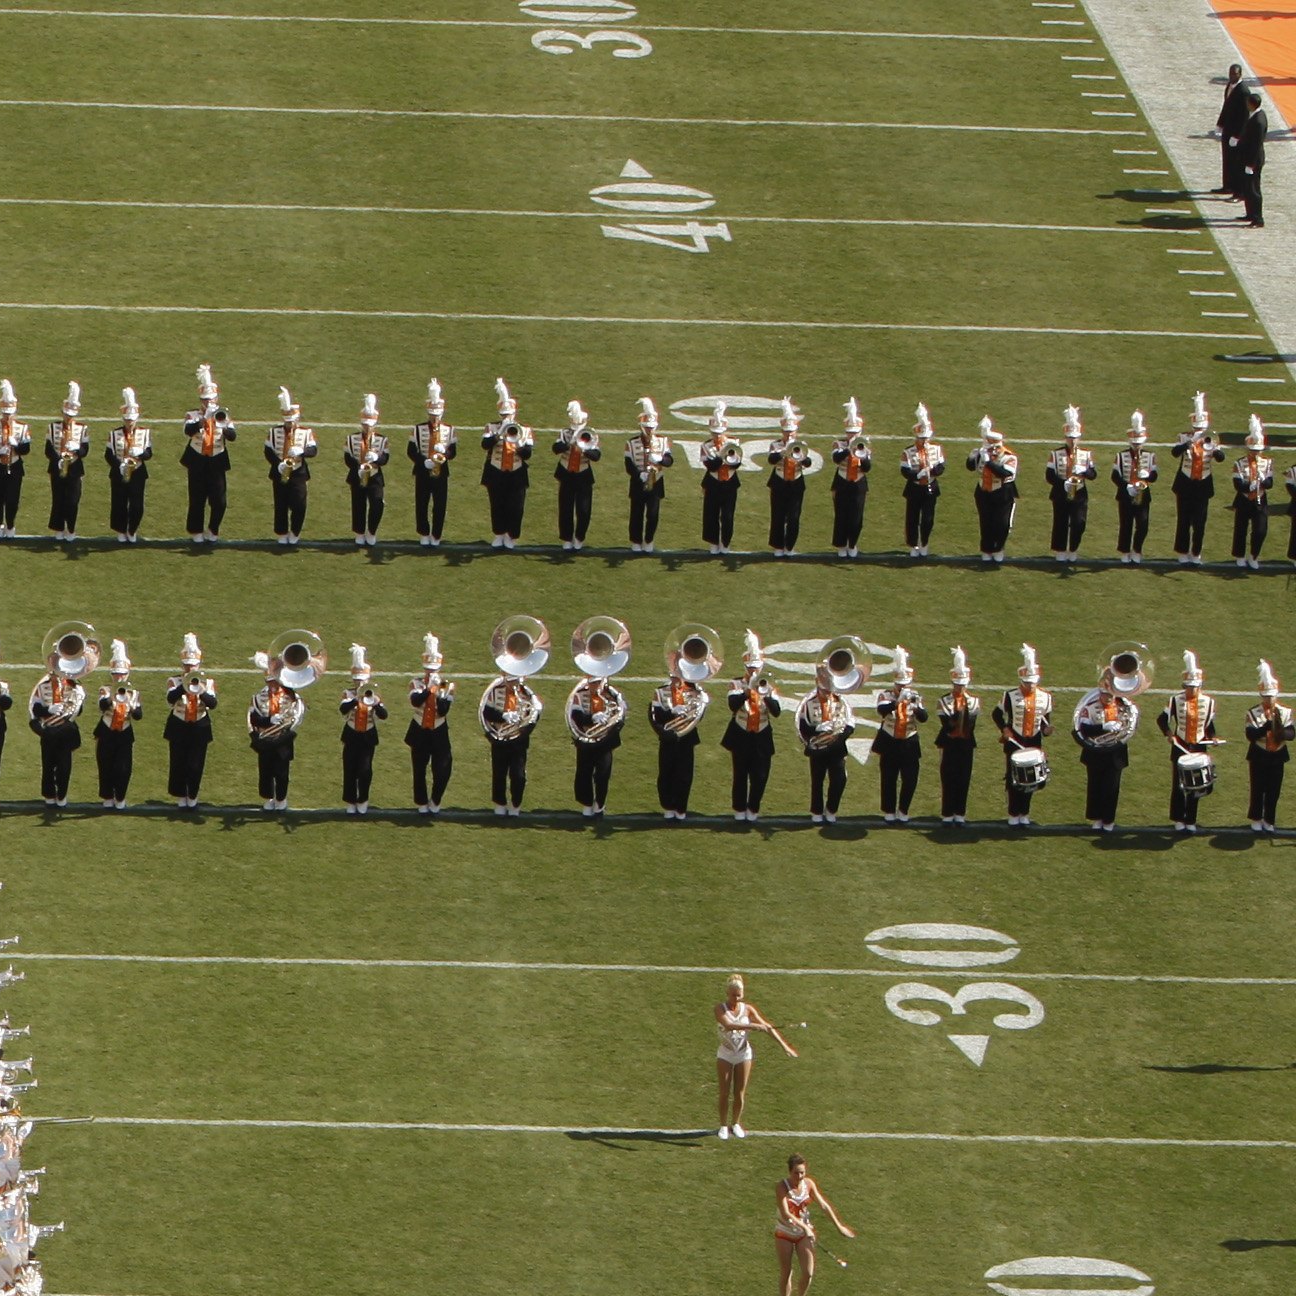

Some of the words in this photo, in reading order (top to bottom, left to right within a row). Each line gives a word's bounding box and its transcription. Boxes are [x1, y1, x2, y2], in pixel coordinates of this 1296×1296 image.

[518, 0, 653, 58] 30
[589, 181, 733, 254] 40
[864, 922, 1045, 1031] 30
